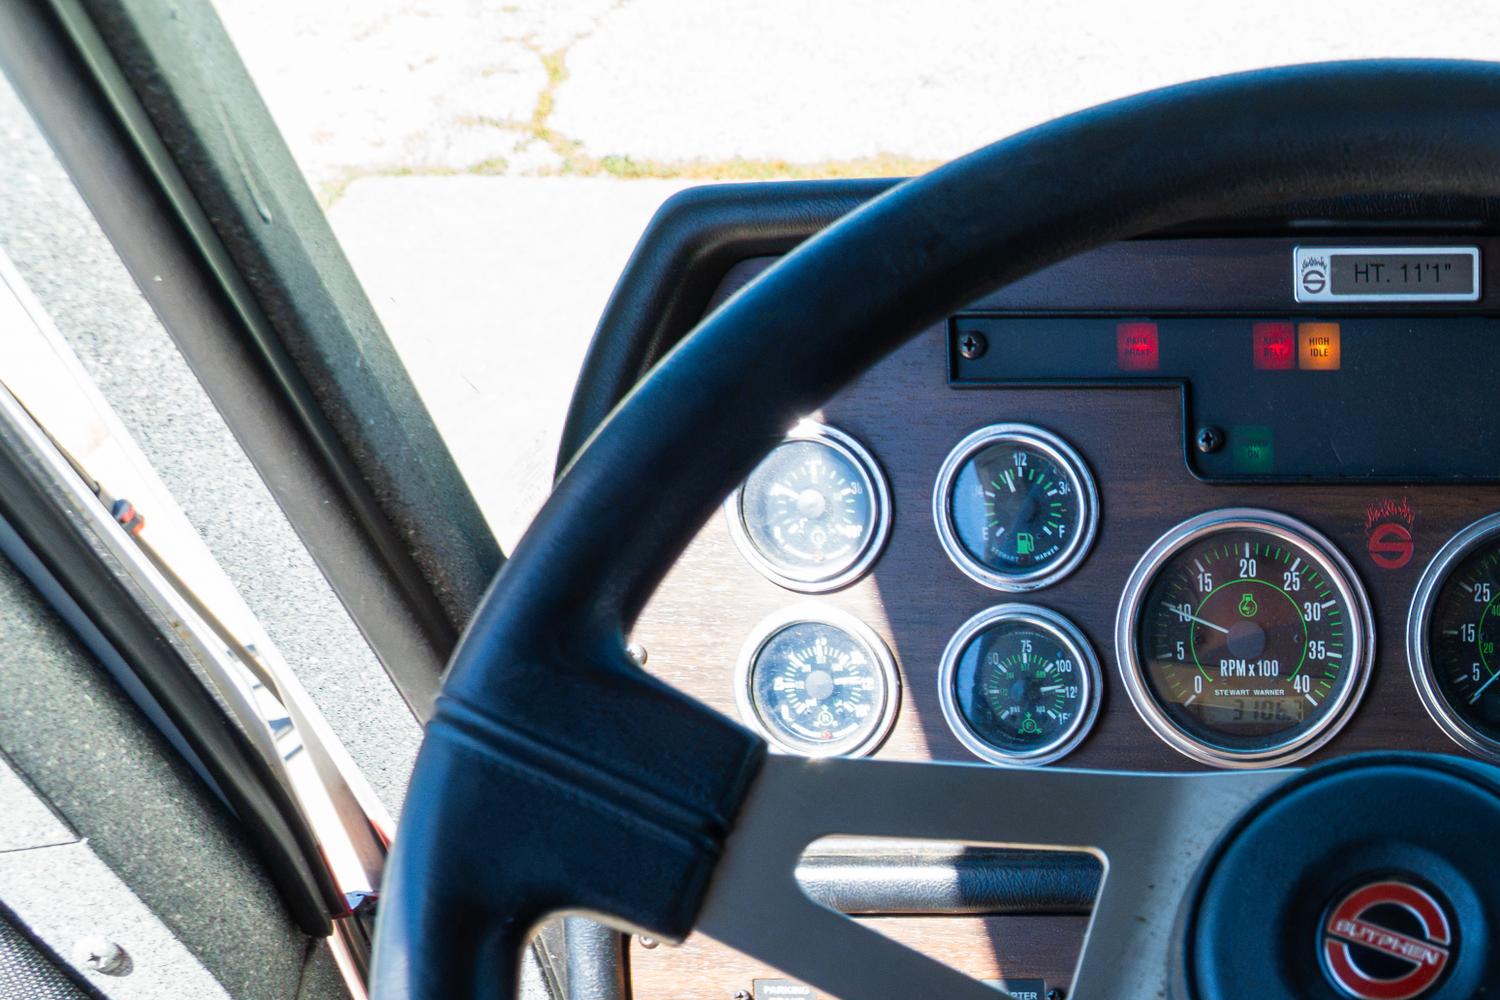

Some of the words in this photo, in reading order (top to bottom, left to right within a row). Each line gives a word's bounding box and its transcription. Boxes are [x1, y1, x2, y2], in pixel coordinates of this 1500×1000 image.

[1354, 263, 1391, 284] HT.
[1400, 263, 1451, 283] 11'1"
[1308, 336, 1330, 346] HIGH
[1310, 348, 1329, 357] IDLE
[1012, 452, 1028, 467] 1/2
[982, 527, 990, 541] E
[1058, 524, 1066, 539] F
[1034, 545, 1060, 562] WARNER
[1239, 559, 1257, 578] 20
[1199, 573, 1213, 592] 15
[1283, 572, 1300, 592] 25
[1474, 583, 1490, 602] 25
[1177, 603, 1192, 622] 10
[1304, 603, 1321, 622] 30
[1461, 623, 1476, 642] 15
[1020, 639, 1032, 653] 75
[1176, 642, 1185, 660] 5
[1309, 641, 1326, 660] 35
[1483, 642, 1494, 654] 20
[1056, 659, 1072, 673] 100
[1220, 659, 1246, 677] RPM
[1257, 659, 1279, 677] 100
[1472, 663, 1480, 681] 5
[1194, 676, 1202, 694] 0
[1214, 688, 1250, 696] STEWART
[1253, 688, 1285, 696] WARNER
[1293, 675, 1310, 693] 40
[762, 984, 810, 996] PARKING
